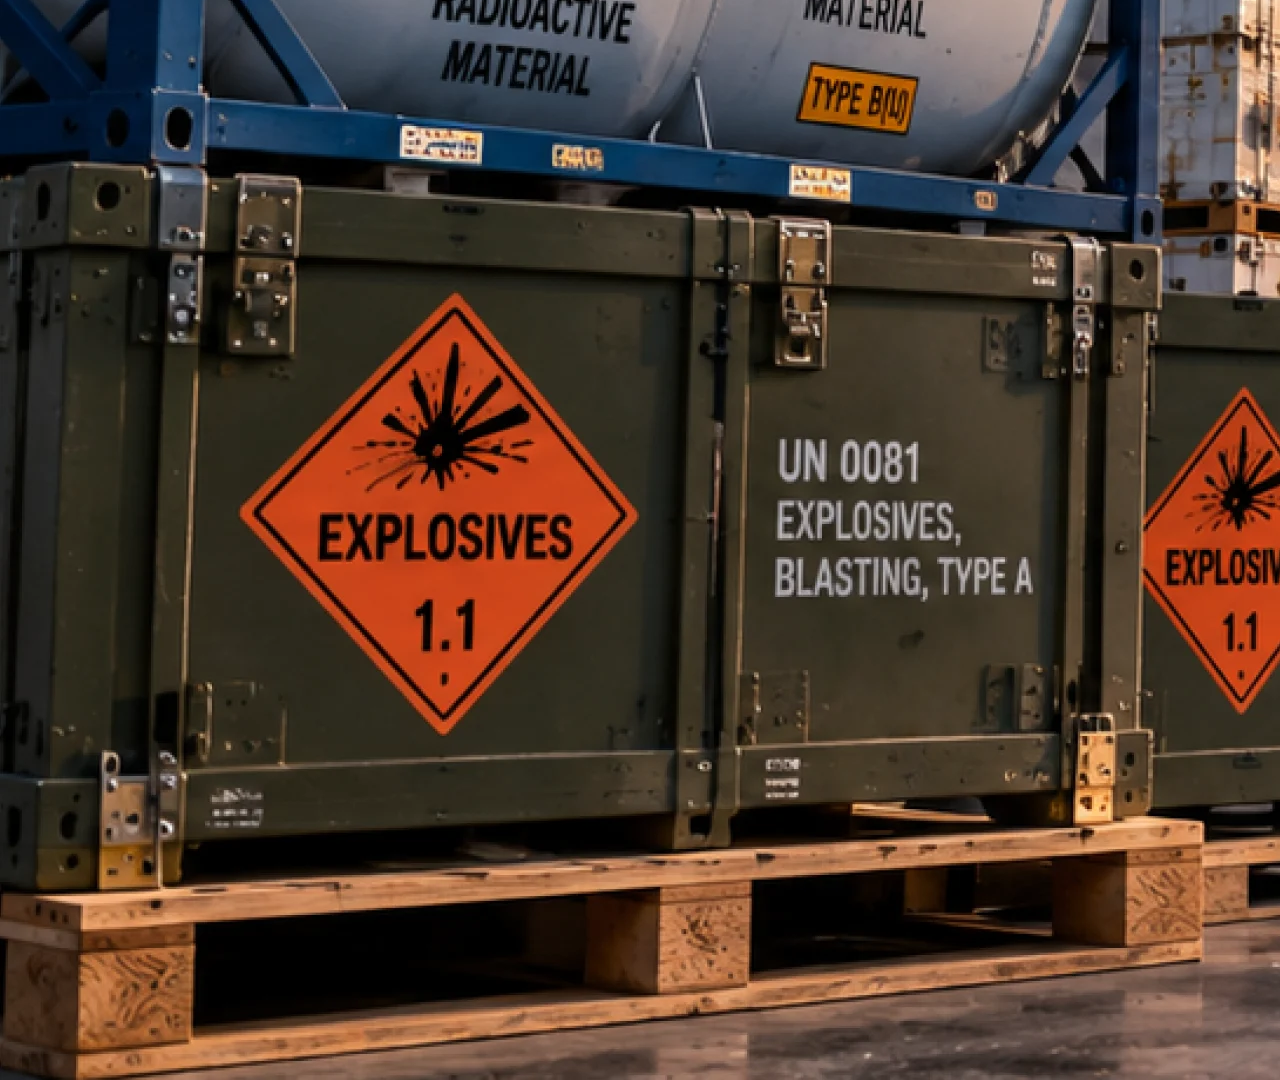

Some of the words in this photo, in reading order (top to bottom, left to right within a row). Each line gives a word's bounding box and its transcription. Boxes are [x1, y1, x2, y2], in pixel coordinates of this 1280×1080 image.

[440, 40, 591, 97] MATERIAL
[812, 76, 865, 115] TYPE
[779, 438, 827, 483] UN
[840, 439, 919, 483] 0081
[317, 511, 574, 562] EXPLOSIVES
[777, 500, 961, 546] EXPLOSIVES,
[774, 556, 929, 602] BLASTING,
[936, 556, 1006, 596] TYPE
[1014, 556, 1034, 594] A
[415, 598, 475, 652] 1.1
[1222, 610, 1257, 652] 1.1
